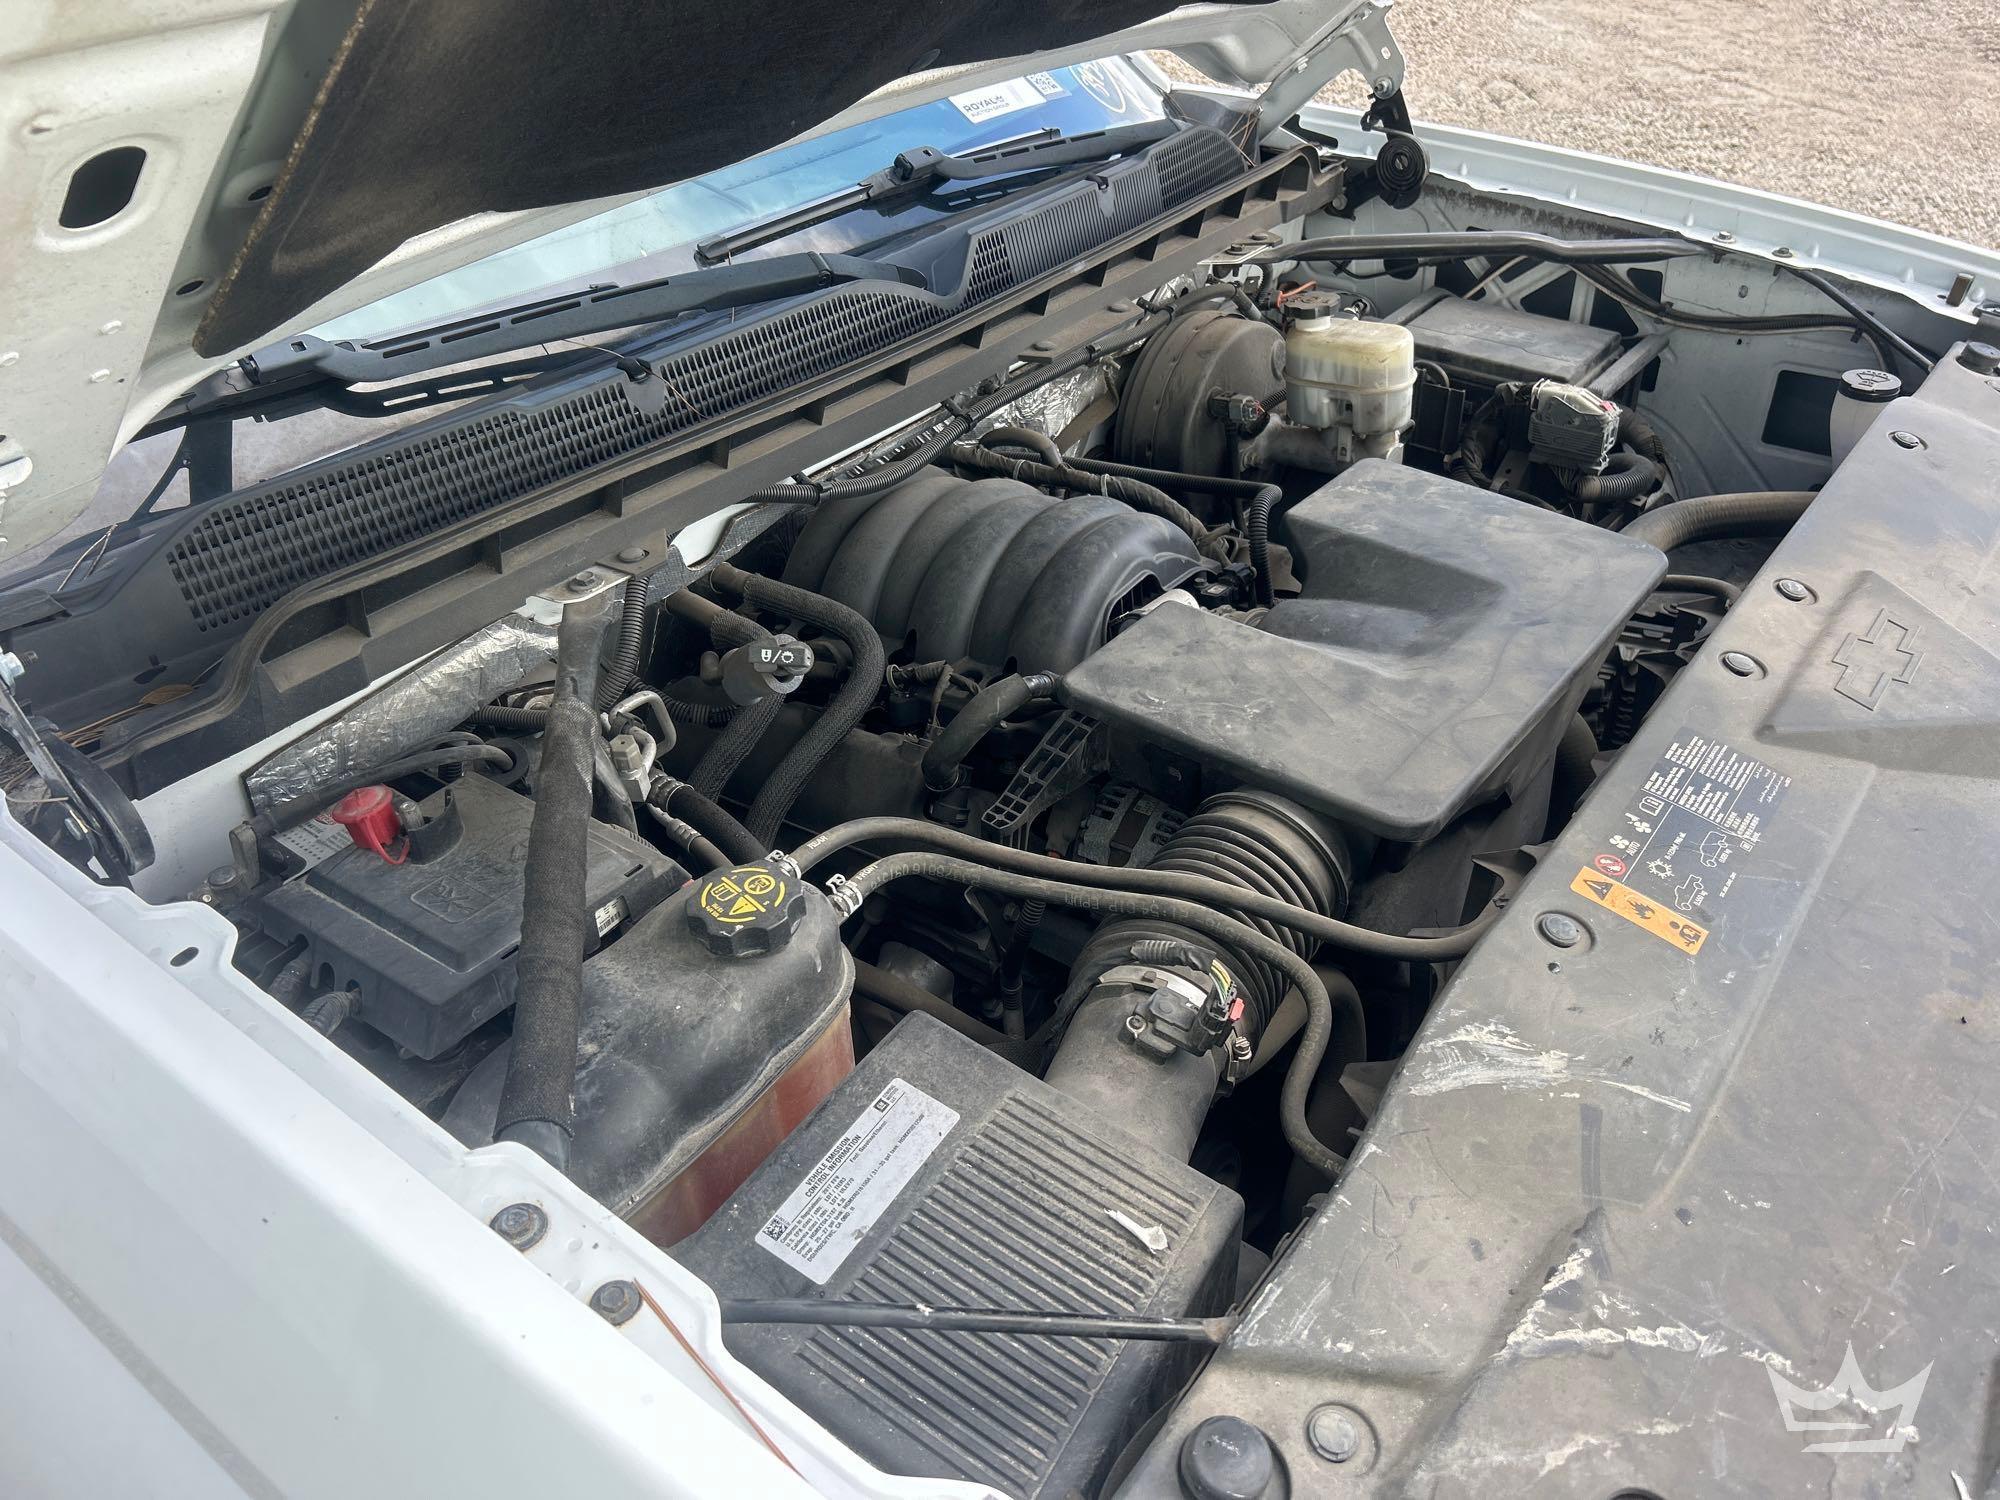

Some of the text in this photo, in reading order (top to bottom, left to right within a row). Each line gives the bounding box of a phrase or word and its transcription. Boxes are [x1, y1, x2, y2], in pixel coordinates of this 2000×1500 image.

[963, 98, 997, 112] ROYAL
[1626, 841, 1640, 856] AUTO
[805, 1136, 851, 1186] VEHICLE EMISSION
[805, 1134, 862, 1198] CONTROL INFORMATION
